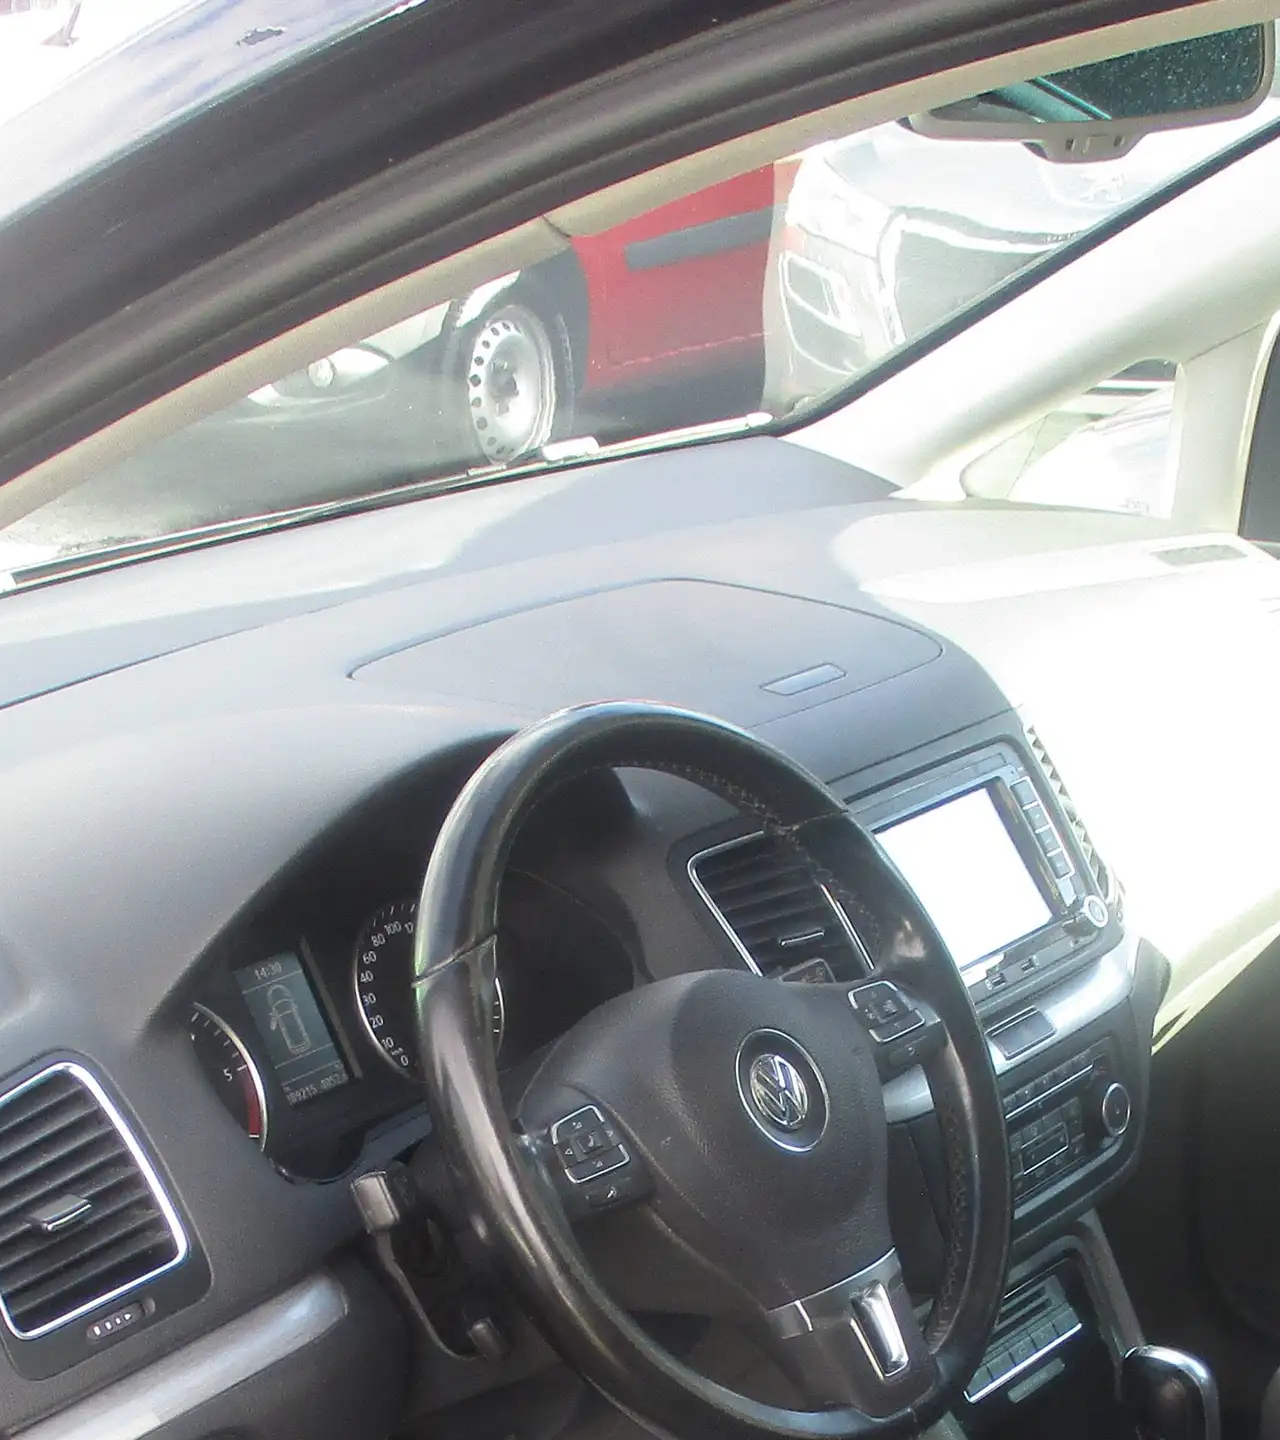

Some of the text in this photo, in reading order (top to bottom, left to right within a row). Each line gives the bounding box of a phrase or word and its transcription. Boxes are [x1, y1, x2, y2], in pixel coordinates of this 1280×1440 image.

[384, 921, 402, 935] 100
[370, 932, 386, 947] 80
[362, 950, 377, 965] 60
[360, 970, 374, 984] 40
[362, 992, 377, 1006] 30
[369, 1015, 384, 1029] 20
[381, 1036, 395, 1050] 10
[400, 1055, 409, 1067] 0
[223, 1068, 233, 1082] 5
